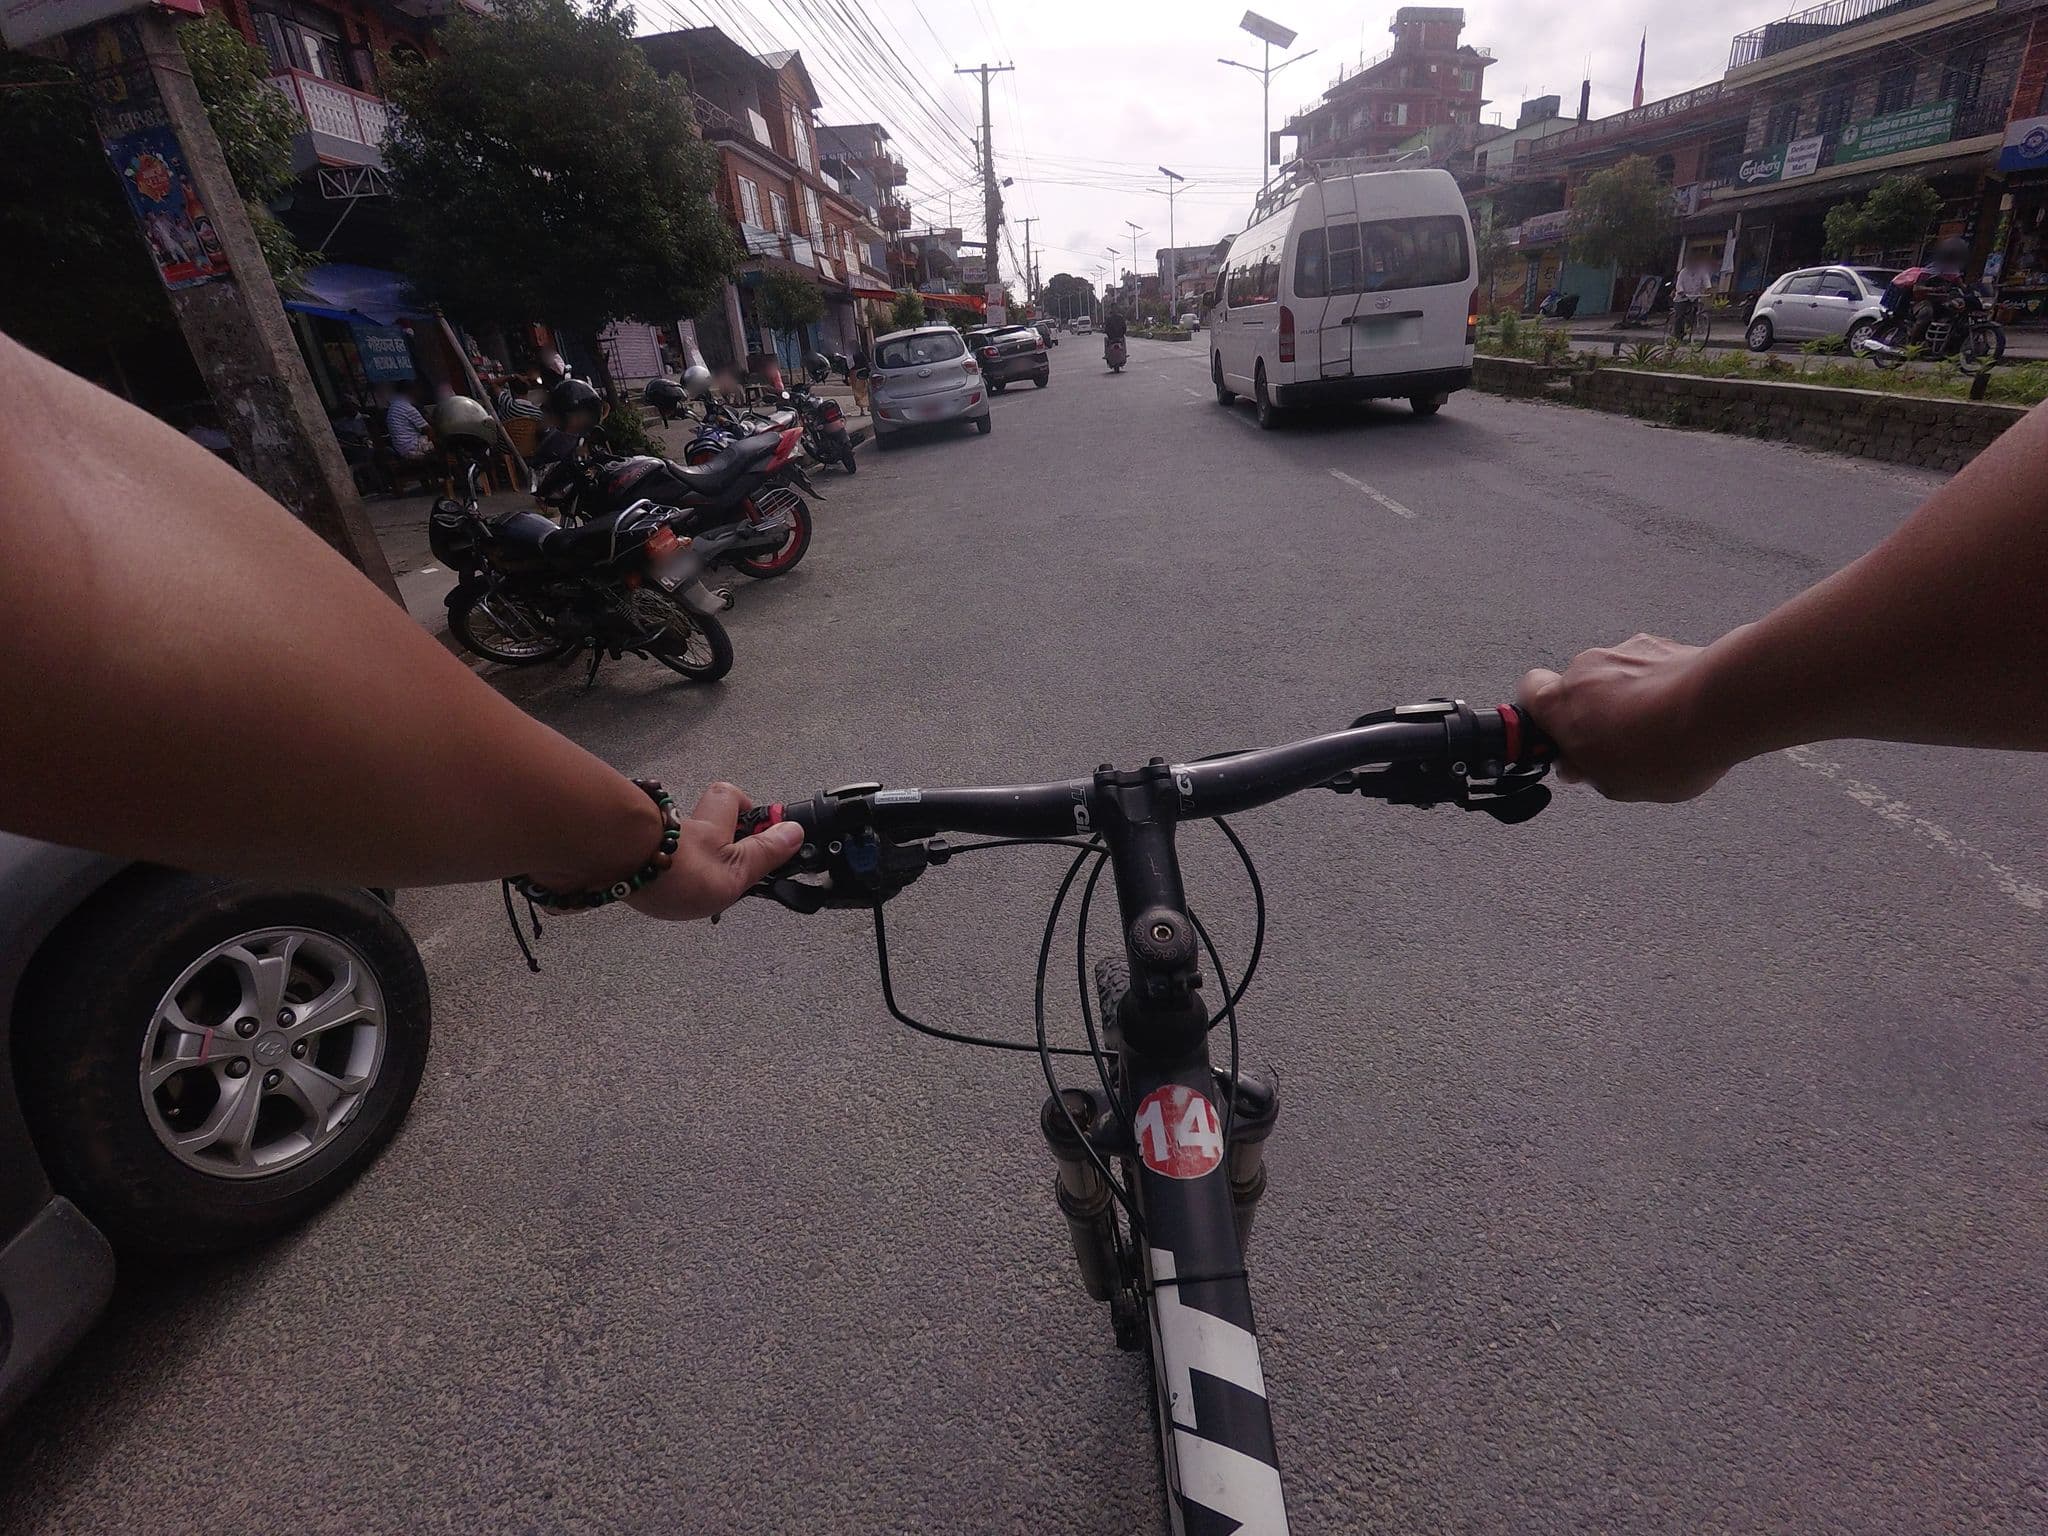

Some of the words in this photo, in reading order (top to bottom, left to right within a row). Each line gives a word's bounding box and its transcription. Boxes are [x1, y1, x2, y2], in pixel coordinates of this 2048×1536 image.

[1739, 157, 1781, 182] Carlsberg
[373, 355, 399, 370] MEDICAL
[399, 355, 413, 369] HALL
[1137, 1097, 1219, 1162] 14
